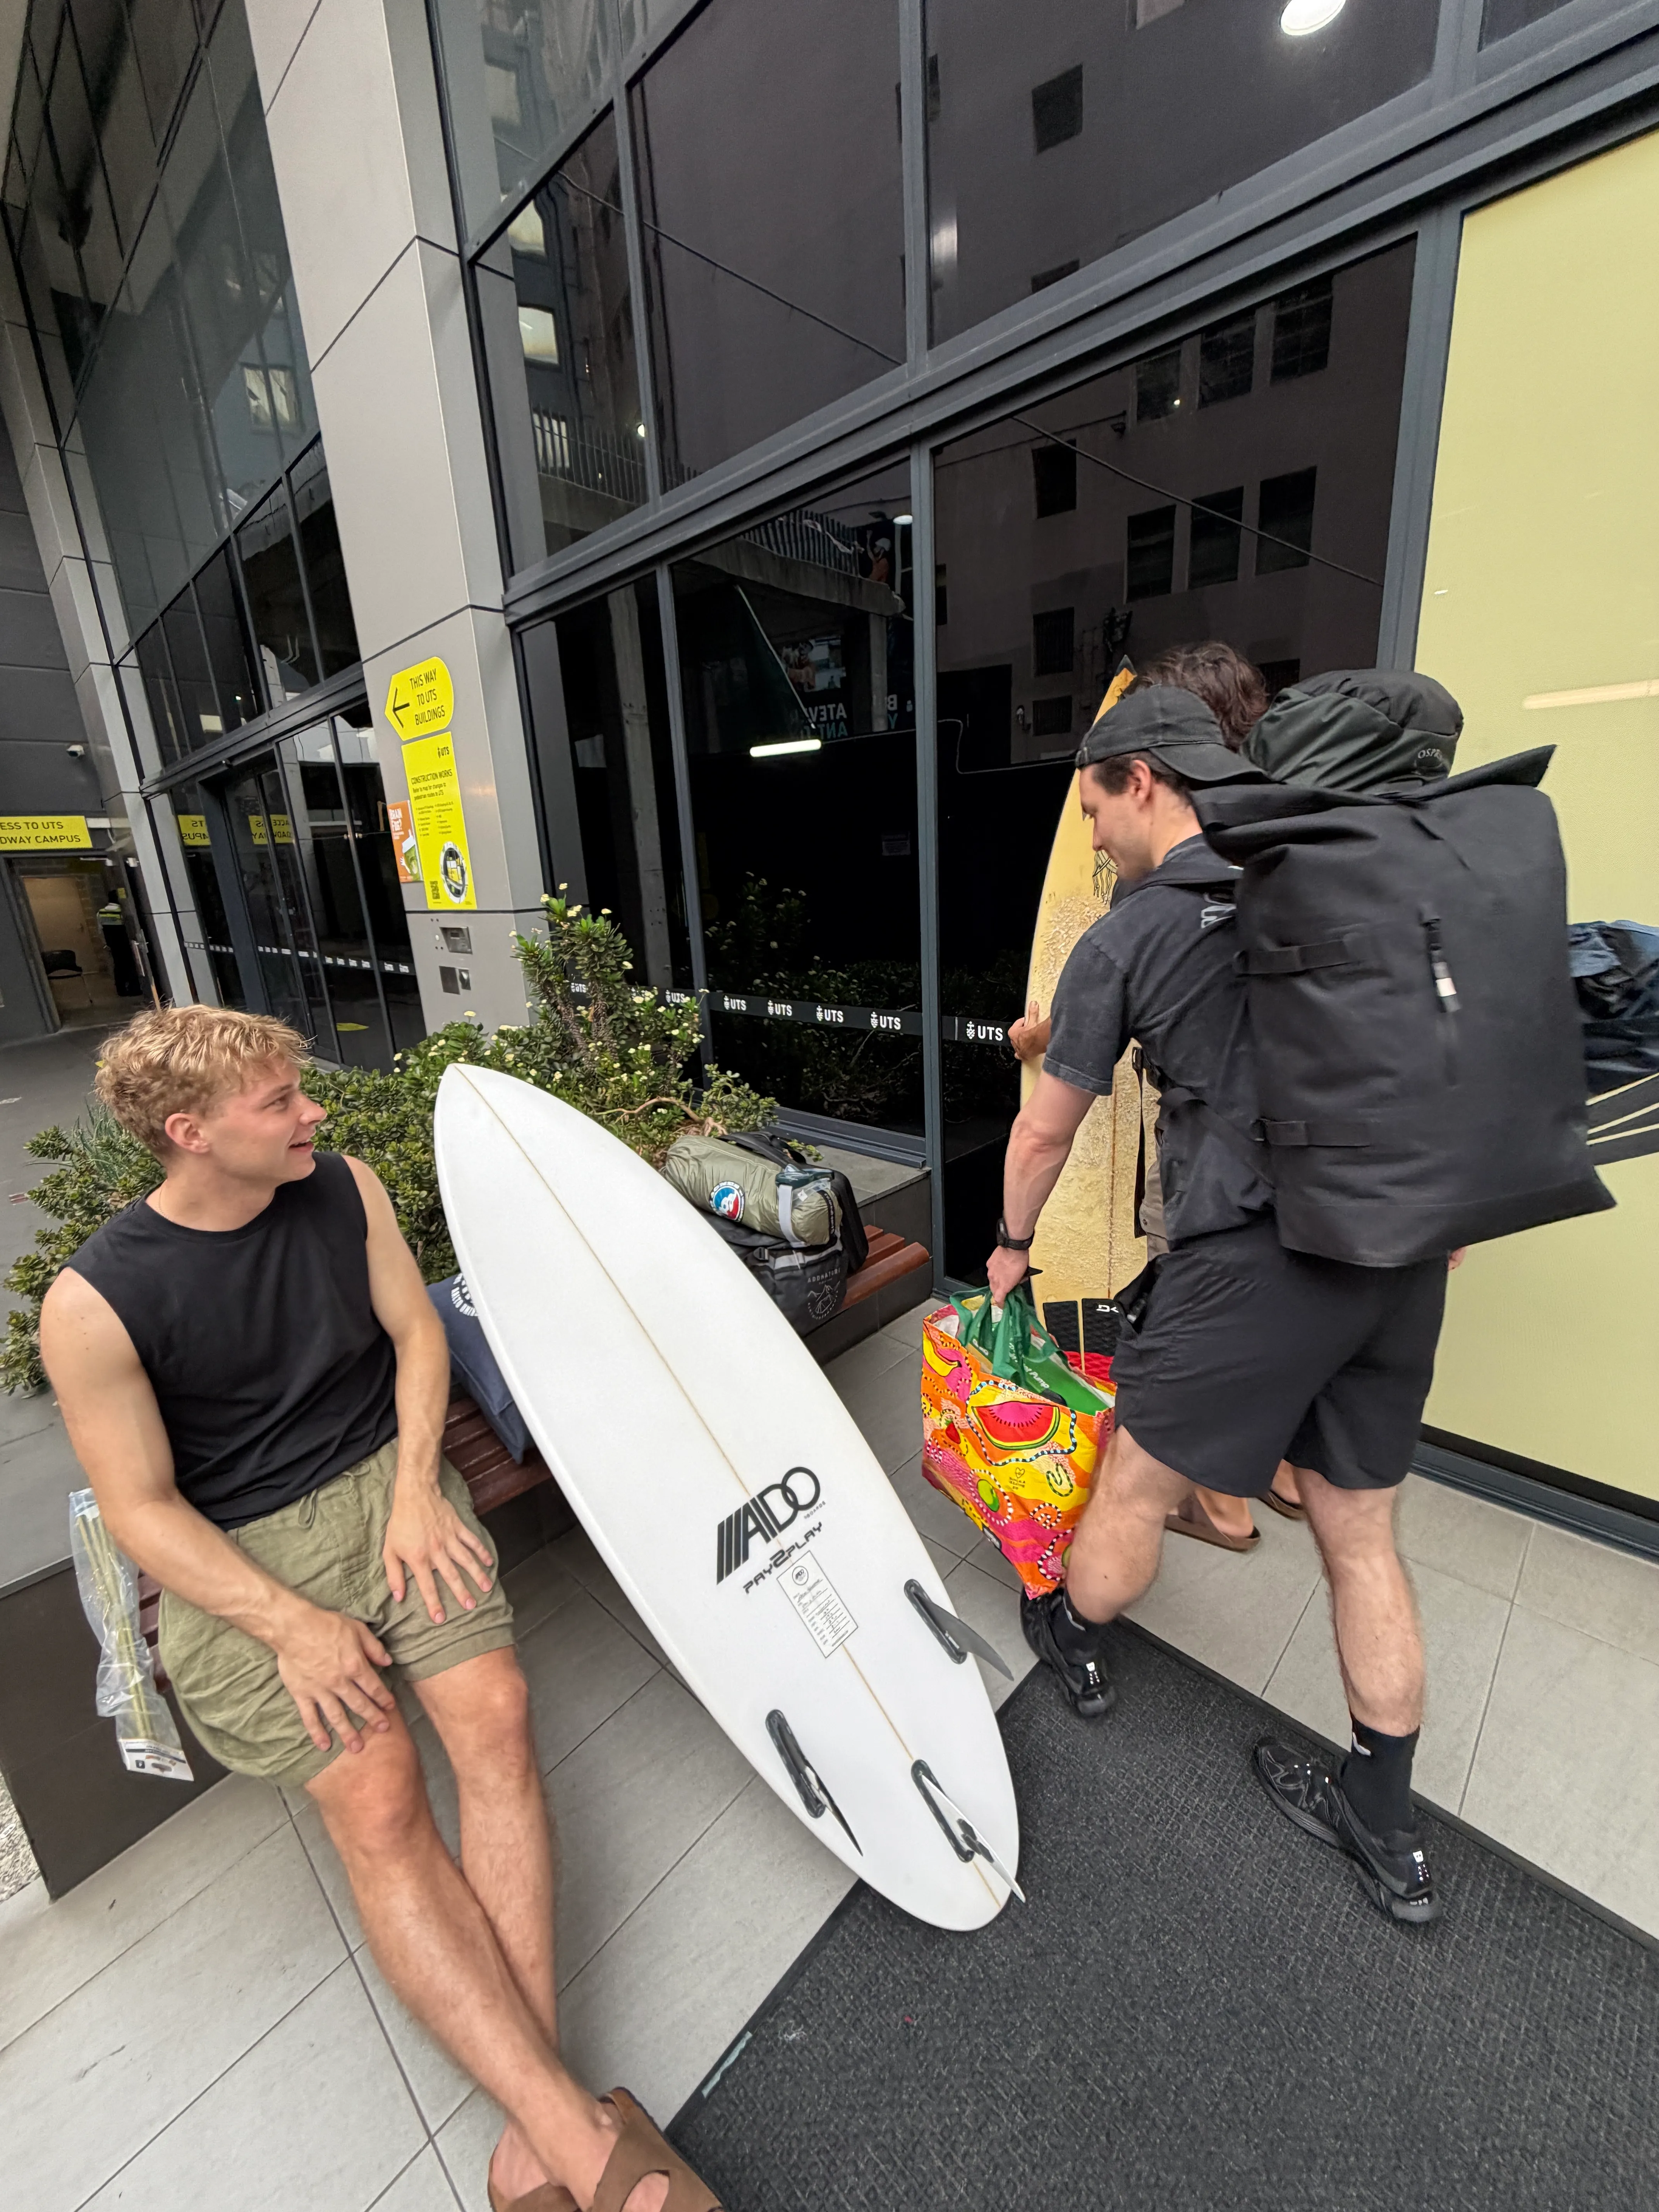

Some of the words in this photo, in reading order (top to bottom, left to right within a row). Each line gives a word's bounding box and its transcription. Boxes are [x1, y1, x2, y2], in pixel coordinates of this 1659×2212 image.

[409, 674, 424, 689] THIS
[424, 668, 436, 684] WAY
[417, 693, 425, 706] TO
[425, 689, 437, 702] UTS
[415, 705, 445, 725] BUILDINGS
[441, 746, 450, 756] UTS
[411, 773, 438, 785] CONSTRUCTION
[438, 769, 453, 778] WORKS
[35, 835, 81, 843] CAMPUS
[730, 999, 747, 1011] UTS
[775, 1003, 792, 1016] UTS
[824, 1009, 843, 1023] UTS
[879, 1015, 902, 1030] UTS
[978, 1025, 1003, 1041] UTS
[743, 1521, 822, 1594] PAY2PLAY
